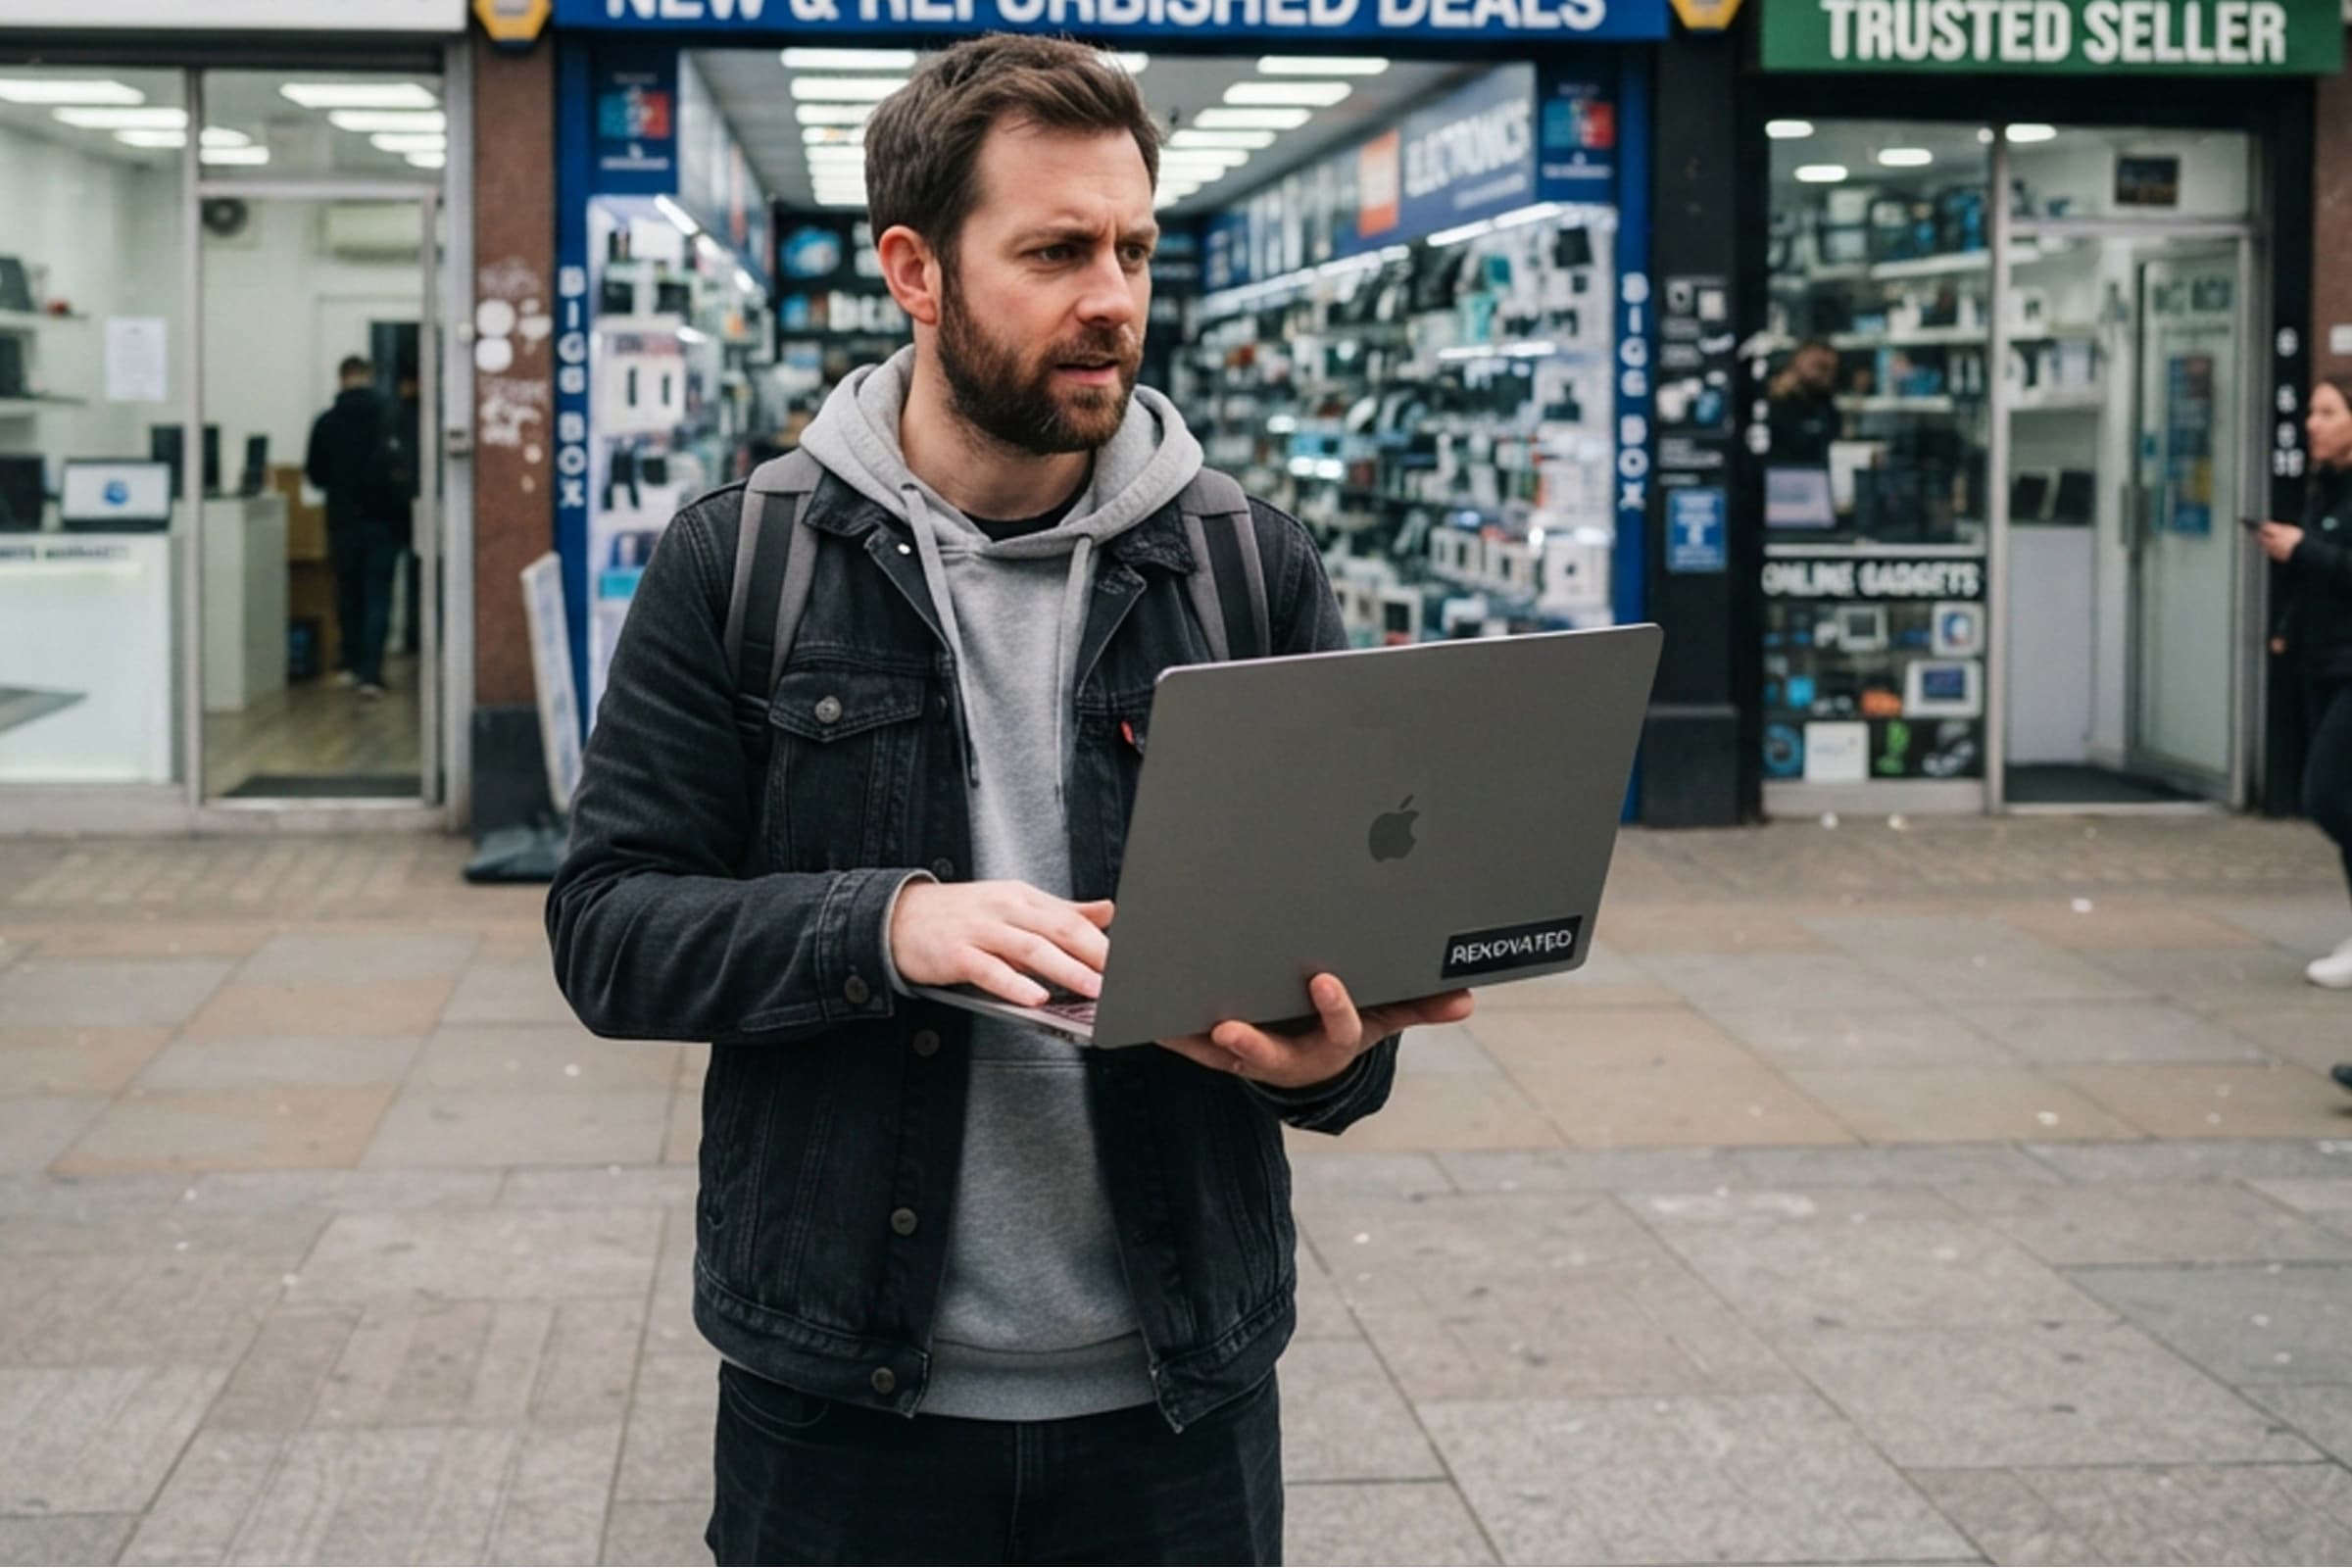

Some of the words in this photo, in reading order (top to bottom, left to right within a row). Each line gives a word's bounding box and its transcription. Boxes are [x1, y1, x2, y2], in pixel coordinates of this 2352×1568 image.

[1820, 0, 2072, 62] TRUSTED
[2082, 0, 2286, 64] SELLER
[558, 412, 586, 508] BOX
[1618, 415, 1648, 509] BOX
